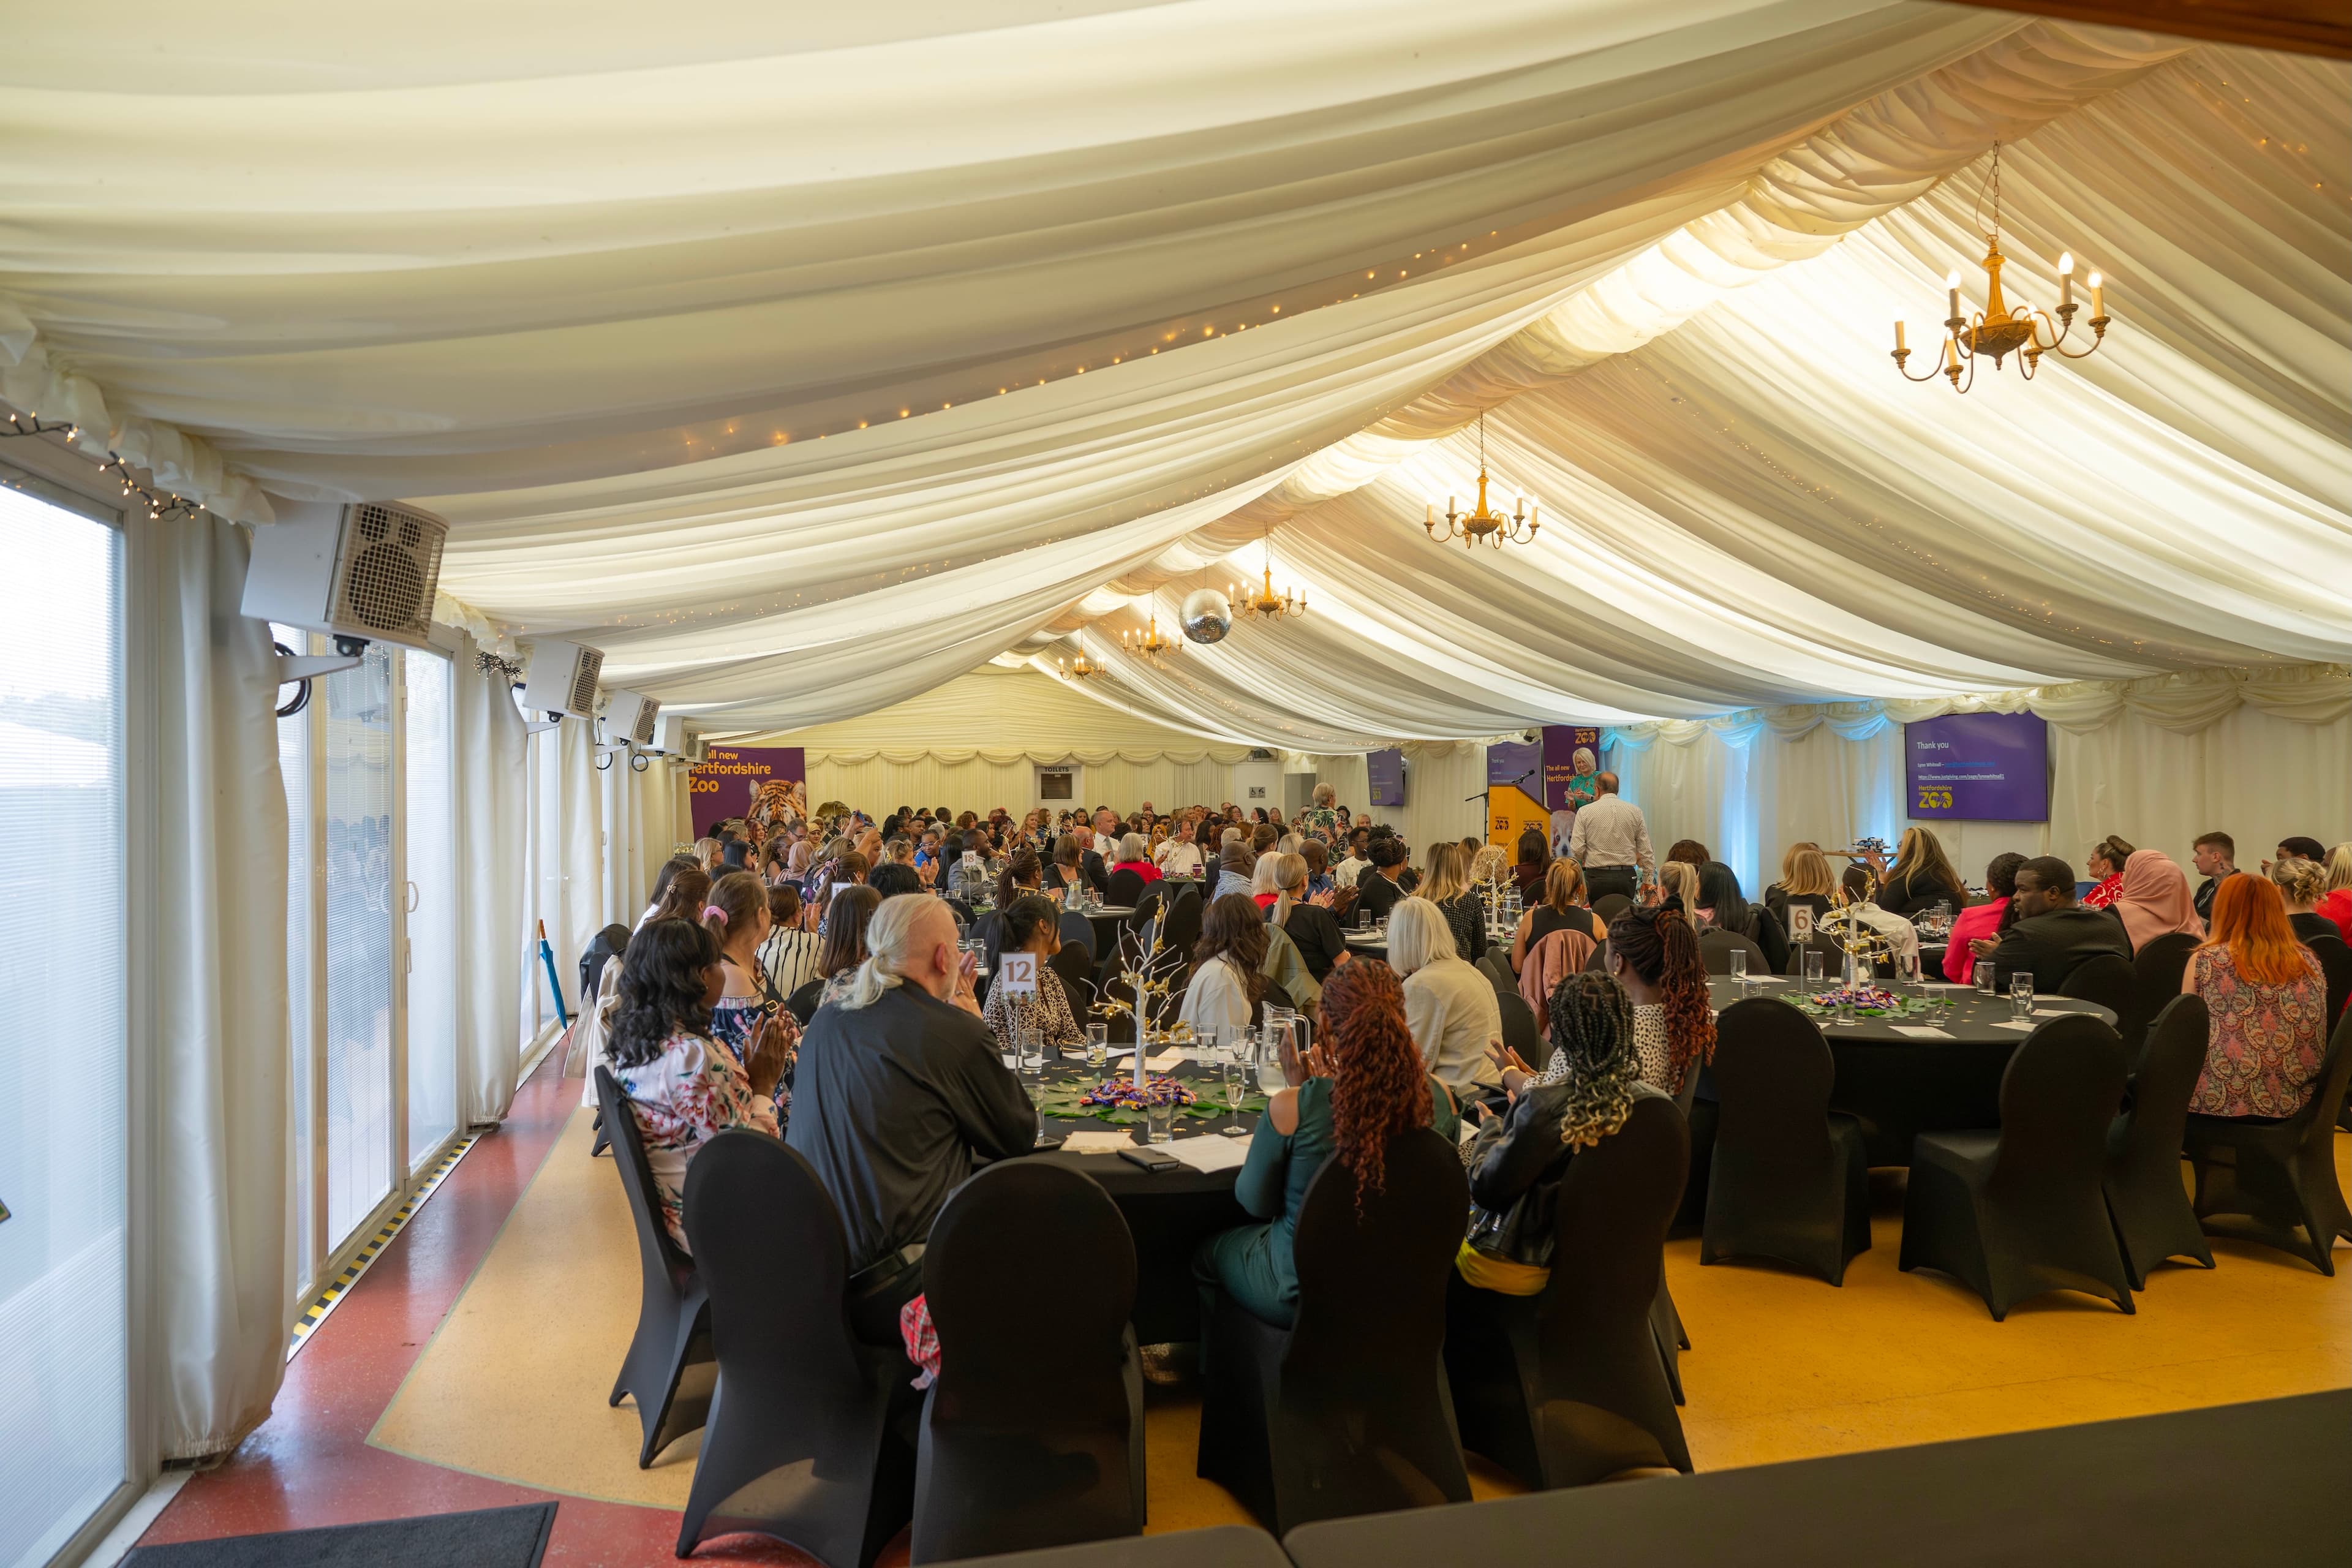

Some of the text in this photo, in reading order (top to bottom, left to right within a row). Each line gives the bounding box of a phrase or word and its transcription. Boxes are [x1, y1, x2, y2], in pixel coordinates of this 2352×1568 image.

[690, 777, 719, 793] Zoo
[1795, 909, 1808, 930] 6
[1005, 960, 1031, 982] 12
